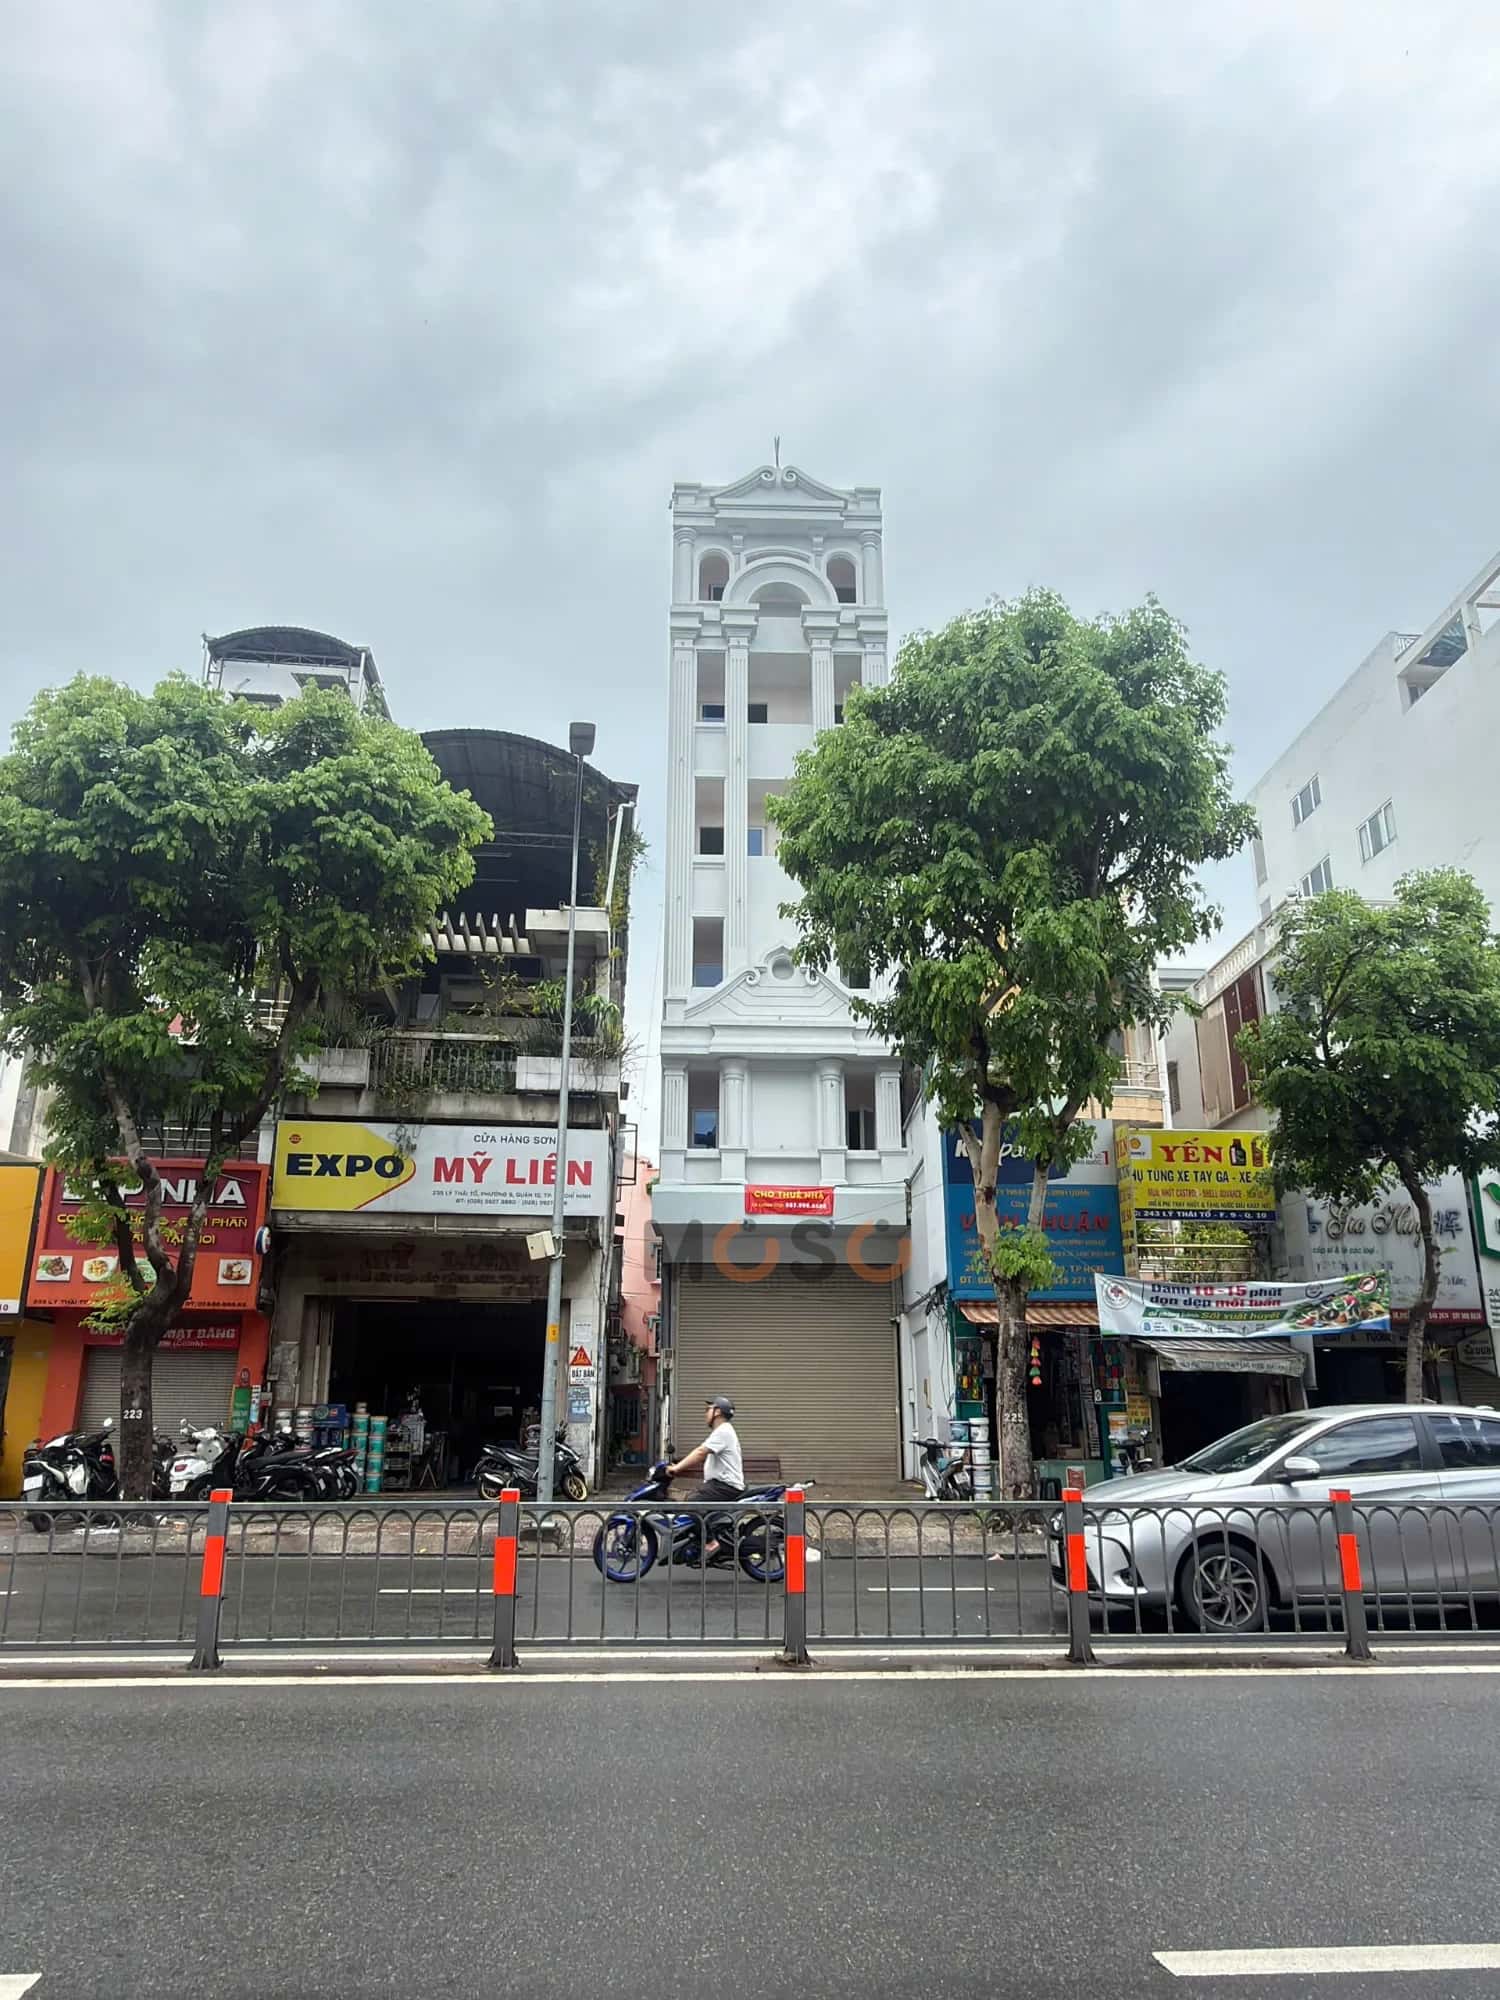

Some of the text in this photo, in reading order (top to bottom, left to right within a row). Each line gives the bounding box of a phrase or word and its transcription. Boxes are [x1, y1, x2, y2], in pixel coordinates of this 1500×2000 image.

[500, 1133, 530, 1145] HÀNG
[1160, 1137, 1223, 1163] YẾN
[287, 1153, 404, 1178] EXPO
[433, 1151, 592, 1186] MỸ LIÊN
[1178, 1171, 1190, 1183] XE
[1193, 1171, 1214, 1183] TAY
[1216, 1172, 1229, 1183] GA
[1239, 1172, 1251, 1183] XE
[753, 1189, 775, 1198] CHO
[123, 1409, 143, 1419] 223
[1004, 1412, 1024, 1422] 225
